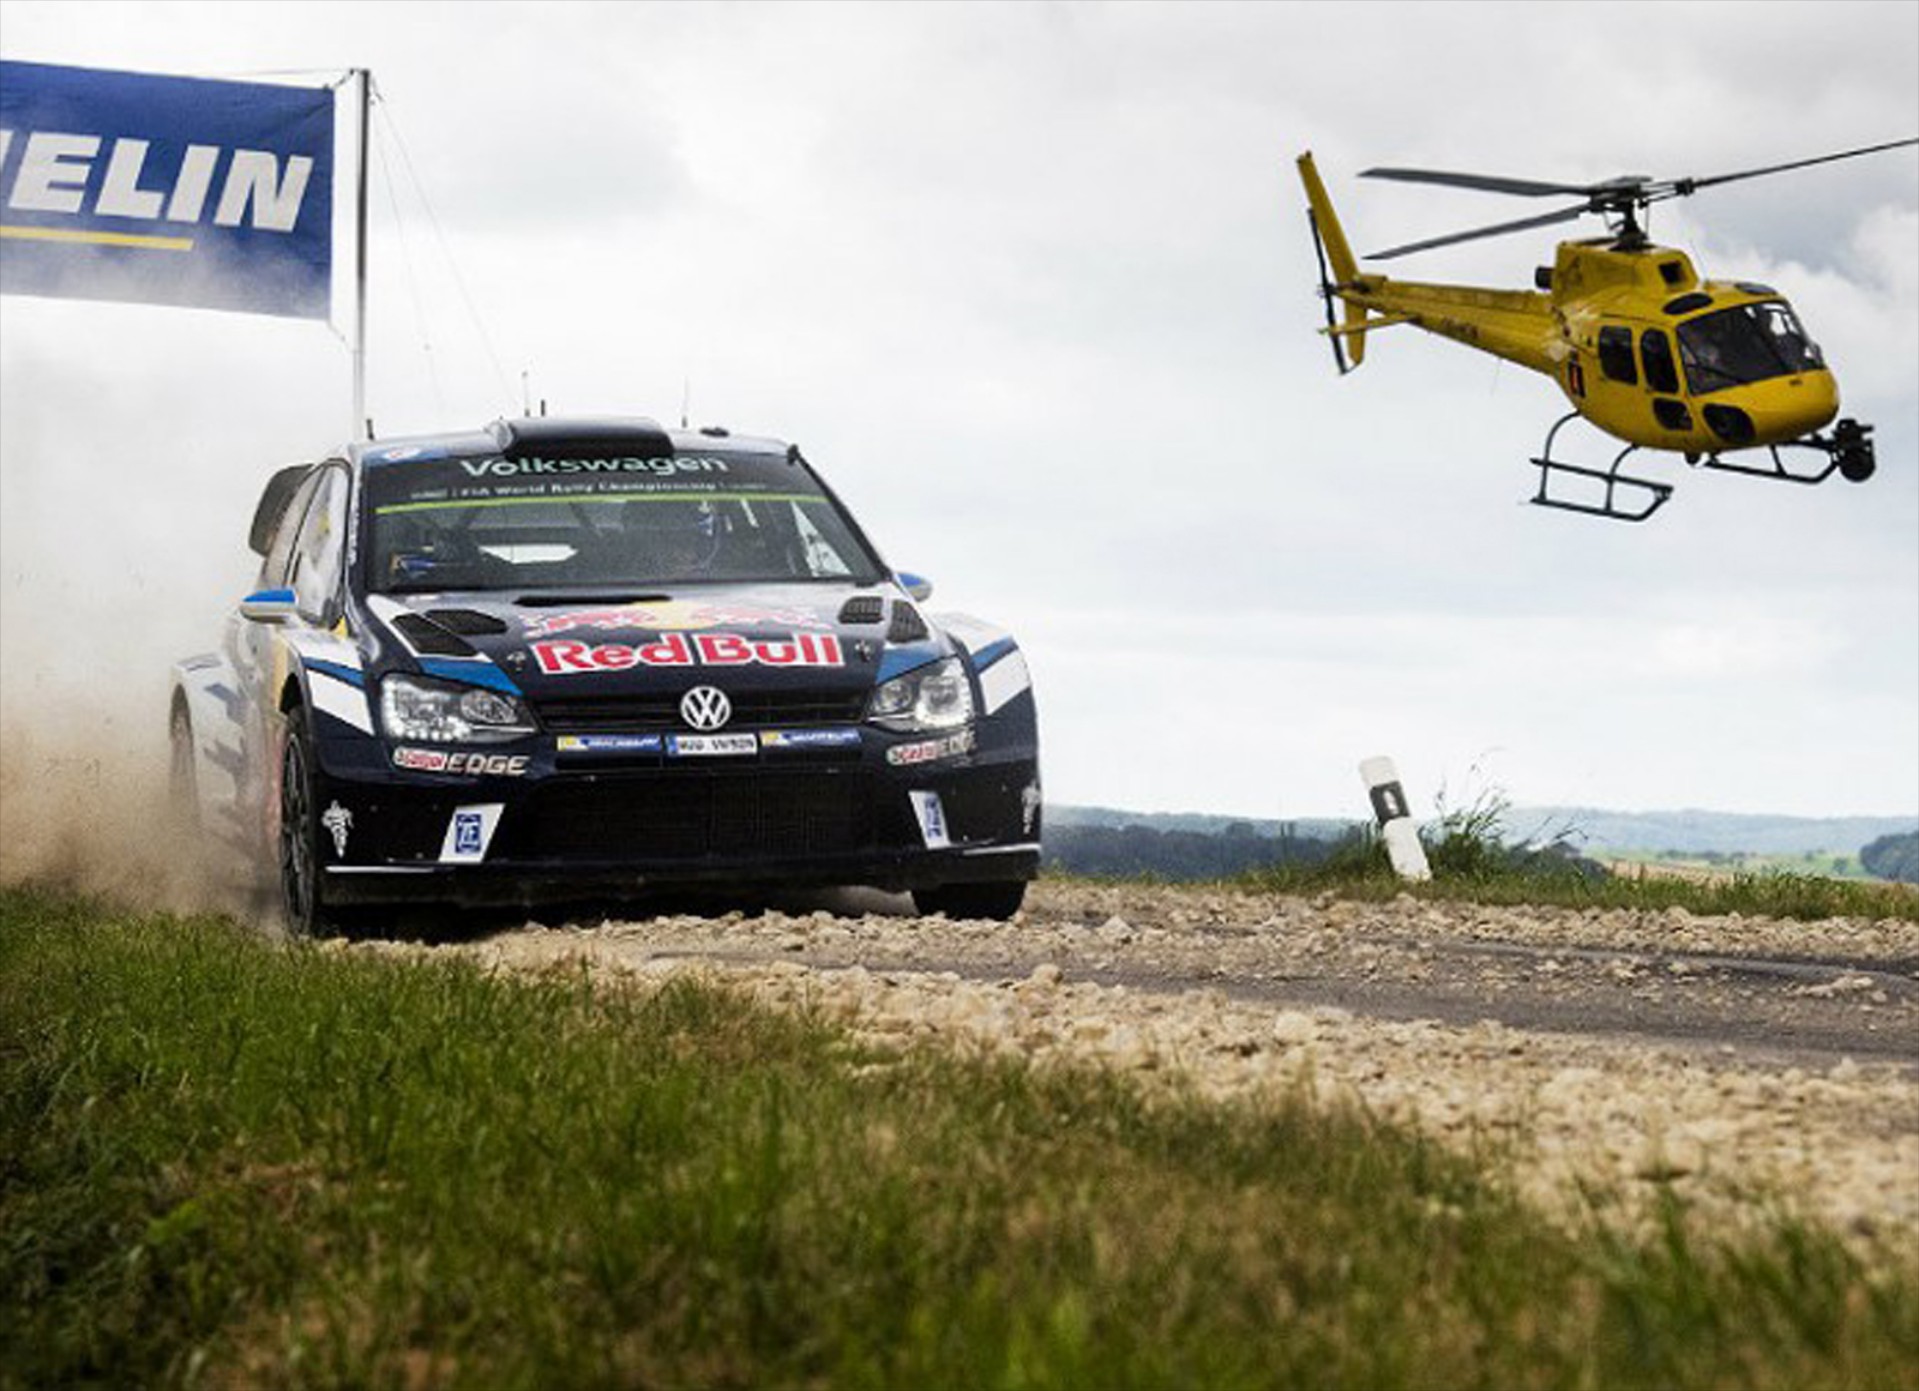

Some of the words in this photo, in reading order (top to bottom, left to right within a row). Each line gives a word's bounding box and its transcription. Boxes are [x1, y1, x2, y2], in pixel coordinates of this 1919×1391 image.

[0, 130, 314, 232] ELIN
[460, 457, 730, 476] Volkswagen
[533, 632, 694, 674] Red
[691, 634, 846, 667] Bull
[448, 753, 530, 774] EDGE
